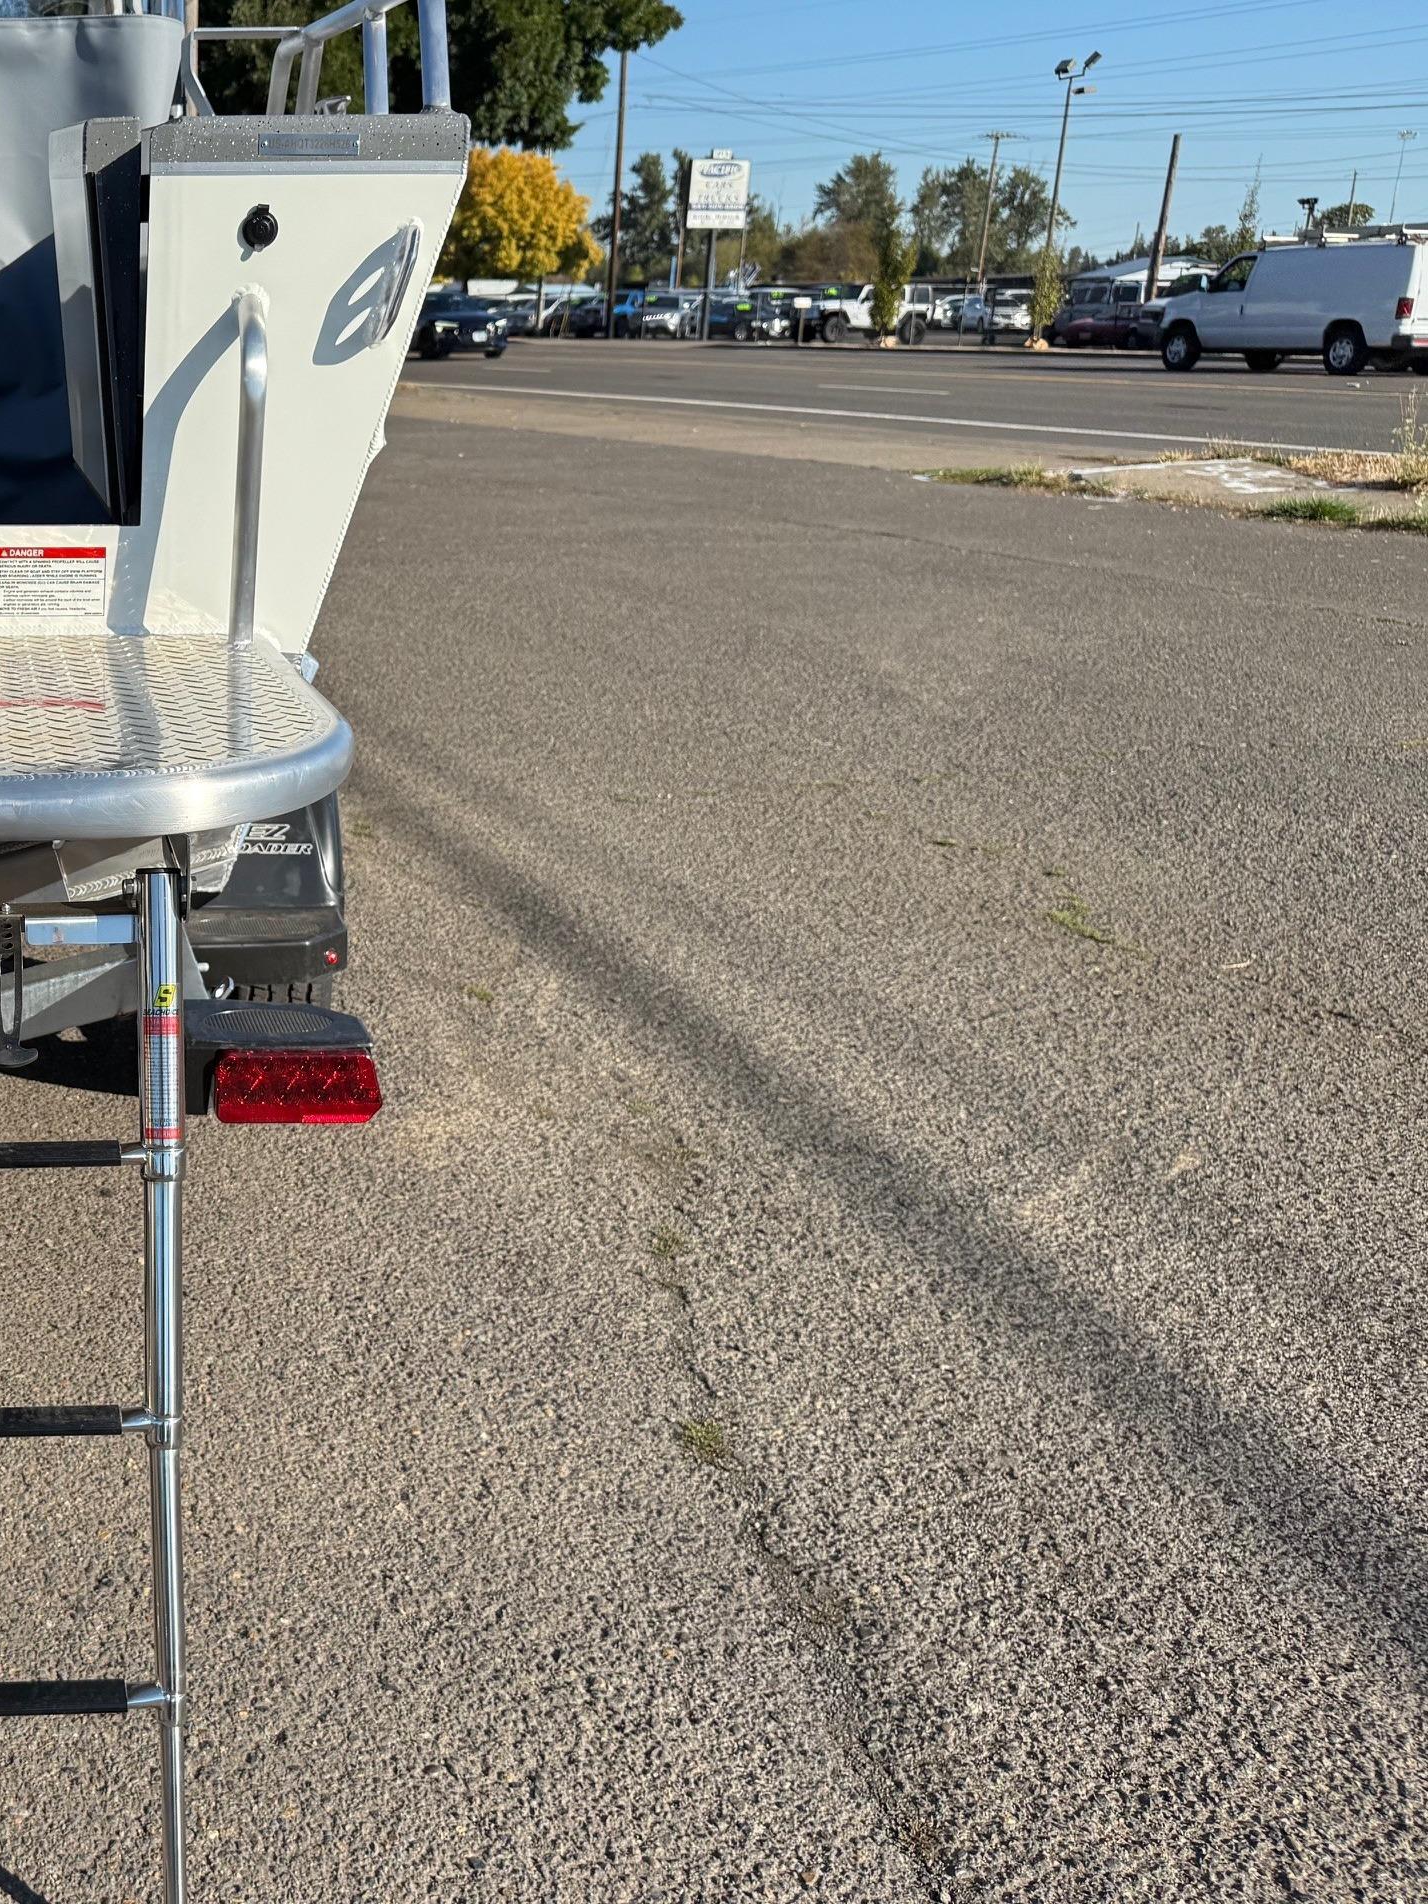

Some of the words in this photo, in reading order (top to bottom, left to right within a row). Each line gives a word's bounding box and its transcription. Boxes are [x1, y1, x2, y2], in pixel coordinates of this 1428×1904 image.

[9, 549, 44, 557] DANGER
[244, 823, 291, 841] EZ
[238, 842, 313, 855] OADER
